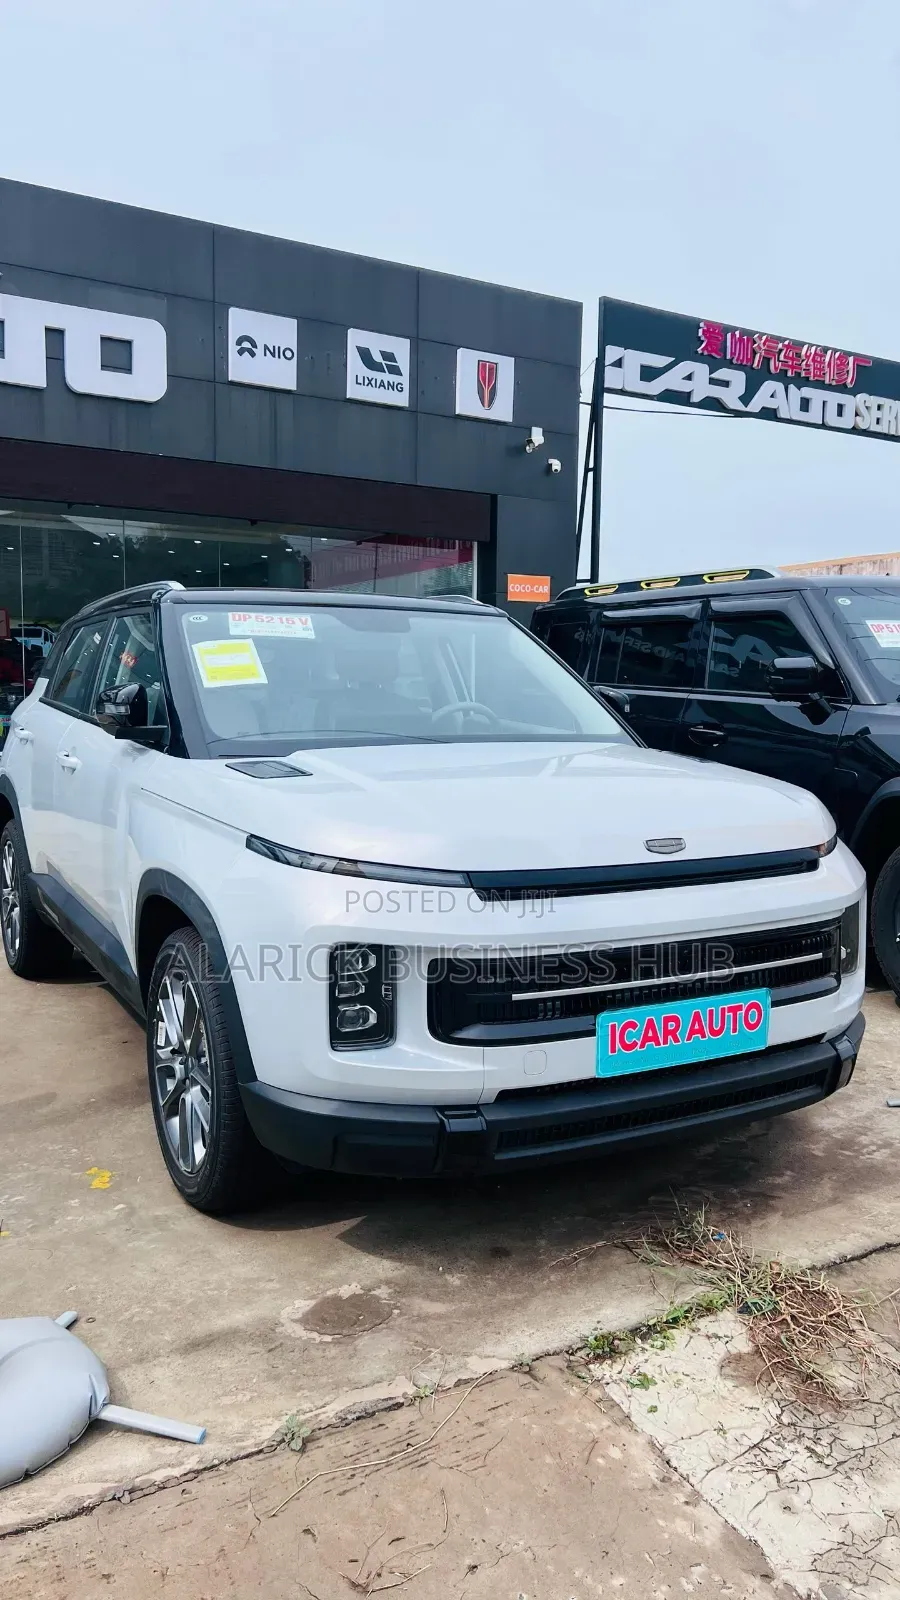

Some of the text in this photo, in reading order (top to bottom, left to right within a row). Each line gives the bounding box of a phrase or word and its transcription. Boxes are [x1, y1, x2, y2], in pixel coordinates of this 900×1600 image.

[263, 343, 295, 361] NIO
[355, 374, 404, 393] LIXIANG
[745, 380, 857, 429] AUTO
[855, 392, 900, 436] SER
[509, 583, 549, 593] COCO-CAR
[231, 612, 309, 626] DP 5215 V
[870, 623, 885, 633] DP
[608, 1013, 682, 1055] ICAR
[684, 1000, 763, 1042] AUTO
